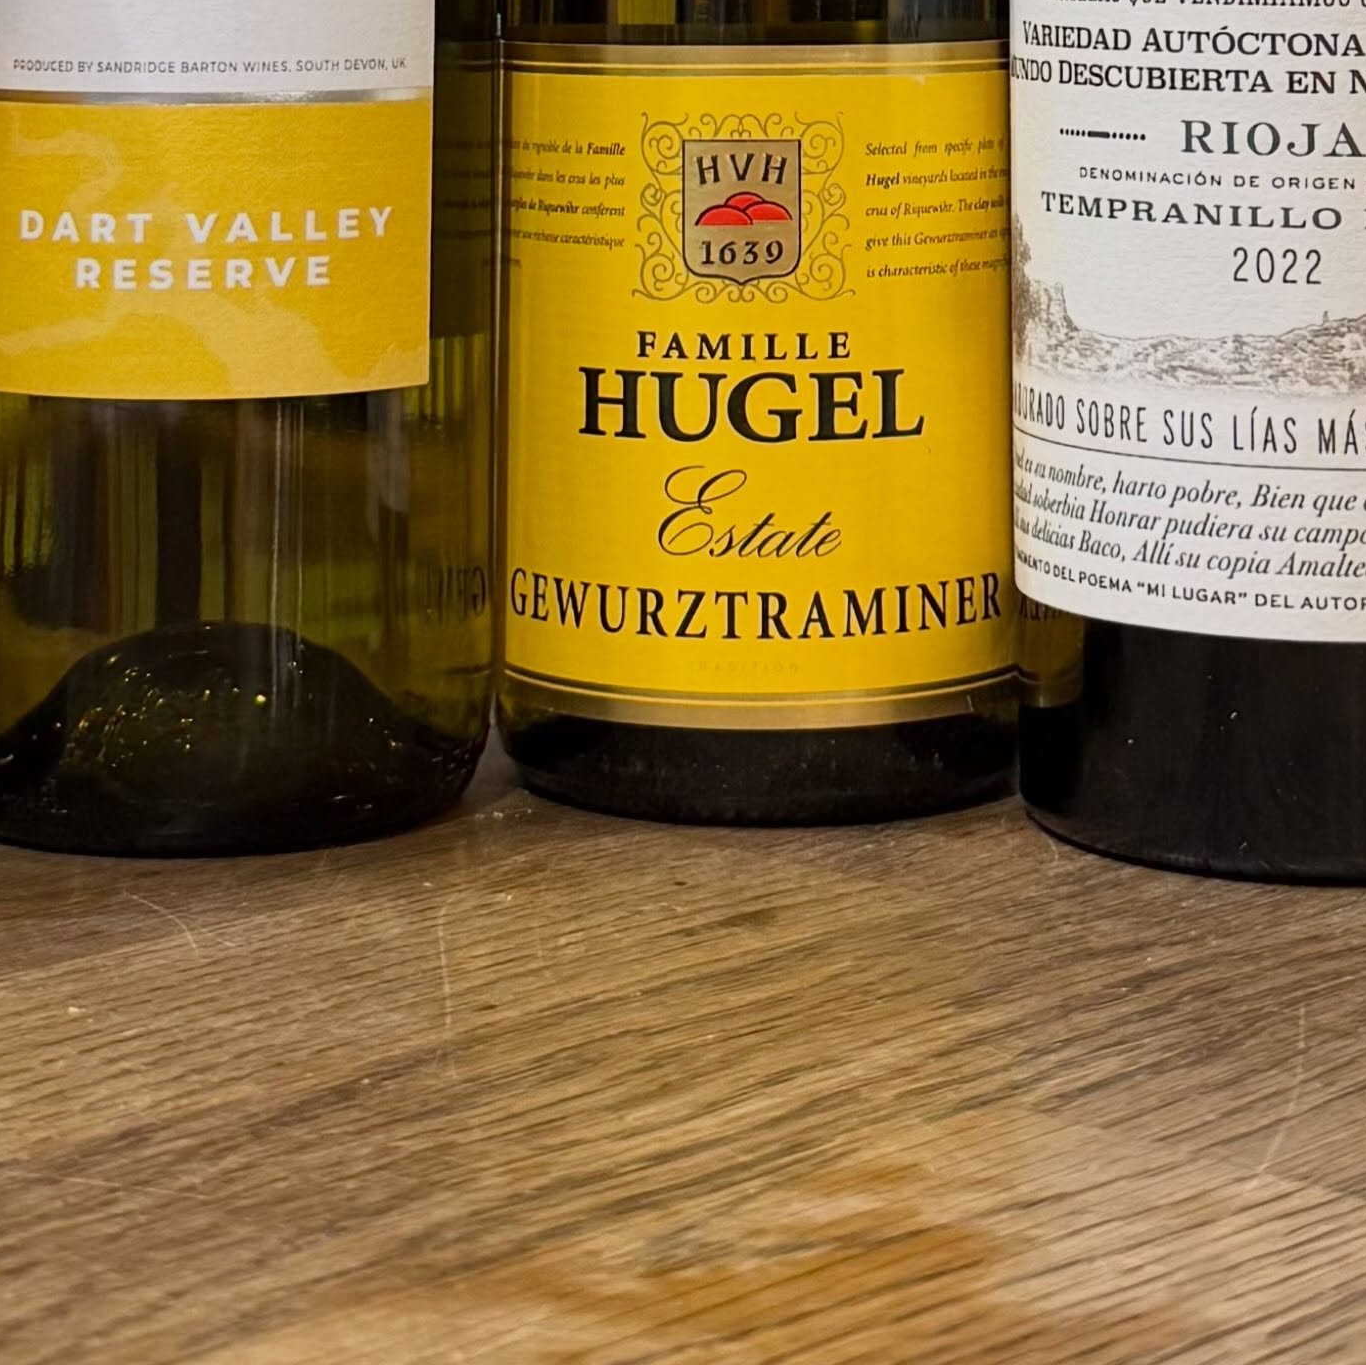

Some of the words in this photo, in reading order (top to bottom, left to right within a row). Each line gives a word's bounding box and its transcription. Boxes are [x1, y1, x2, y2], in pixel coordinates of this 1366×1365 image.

[1022, 20, 1132, 52] VARIEDAD
[1141, 25, 1365, 58] AUTÓCTONA
[14, 59, 74, 73] PRODUCED
[78, 60, 93, 72] BY
[97, 60, 175, 73] SANDRIDGE
[181, 60, 237, 73] BARTON
[296, 59, 339, 72] SOUTH
[392, 57, 406, 69] UK
[1059, 59, 1273, 93] DESCUBIERTA
[1286, 69, 1336, 94] EN
[1181, 119, 1366, 158] RIOJA
[696, 154, 787, 186] HVH
[866, 171, 899, 189] Hugel
[1080, 167, 1222, 187] DENOMINACIÓN
[1234, 176, 1259, 188] DE
[1272, 176, 1356, 190] ORIGEN
[21, 209, 153, 243] DART
[187, 206, 393, 242] VALLEY
[1041, 191, 1343, 230] TEMPRANILLO
[701, 239, 784, 267] 1639
[1233, 247, 1323, 285] 2022
[76, 257, 330, 290] RESERVE
[637, 332, 850, 360] FAMILLE
[578, 367, 925, 443] HUGEL
[1076, 398, 1147, 442] SOBRE
[1163, 409, 1213, 449] SUS
[1233, 406, 1297, 454] LÍAS
[1048, 463, 1106, 494] nombre,
[1112, 470, 1166, 499] harto
[1169, 479, 1242, 509] pobre,
[1250, 483, 1305, 509] Bien
[1313, 493, 1357, 517] que
[658, 465, 842, 558] Estate
[1034, 488, 1085, 521] soberbia
[1089, 499, 1161, 531] Honrar
[1162, 512, 1253, 541] pudiera
[1259, 524, 1286, 542] su
[1078, 530, 1126, 563] Baco,
[1132, 539, 1174, 566] Allí
[1175, 554, 1201, 569] su
[1207, 551, 1270, 580] copia
[511, 567, 1001, 642] GEWURZTRAMINER
[1053, 565, 1075, 583] DEL
[1079, 571, 1132, 593] POEMA
[1255, 593, 1295, 609] DEL
